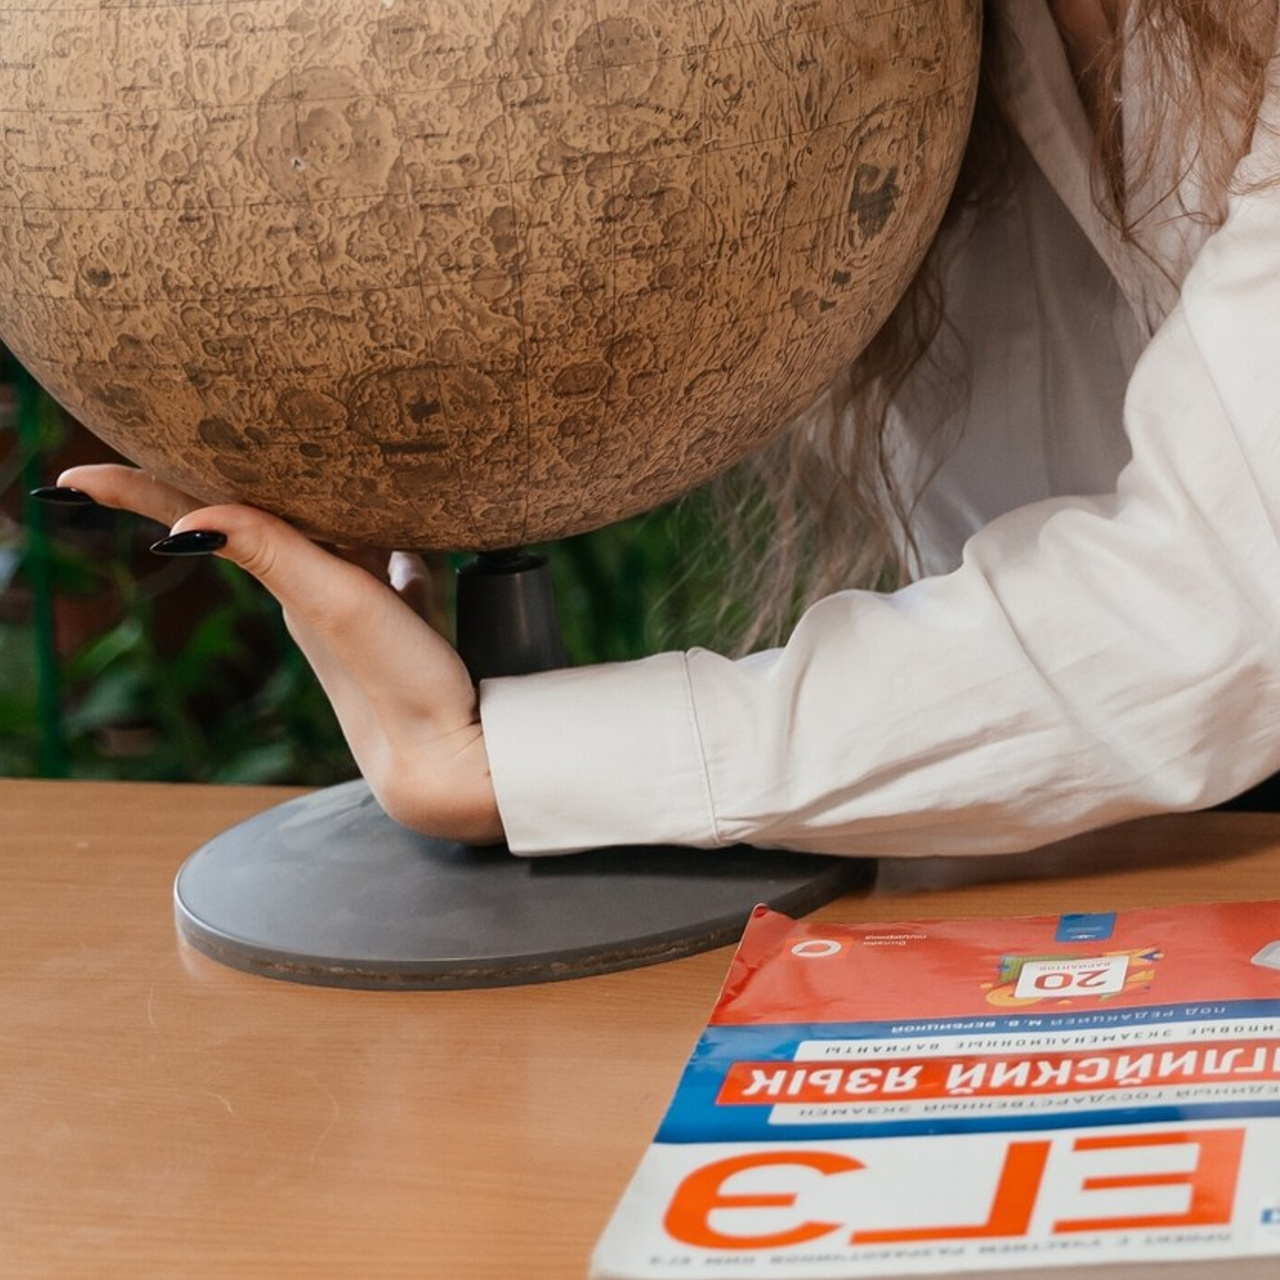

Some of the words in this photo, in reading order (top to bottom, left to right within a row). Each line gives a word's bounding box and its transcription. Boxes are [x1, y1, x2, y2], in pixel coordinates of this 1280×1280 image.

[1039, 962, 1111, 972] ВАРИАНТОВ
[1033, 969, 1110, 990] 20
[1050, 1009, 1174, 1026] РЕДАКЦИЕЙ
[1183, 1006, 1226, 1017] ПОД
[891, 1021, 997, 1034] ВЕРБИЦКОЙ
[953, 1031, 1172, 1049] ЭКЗАМЕНАЦИОННЫЕ
[825, 1042, 940, 1054] ВАРИАНТЫ
[741, 1065, 923, 1096] ЯЗЫК
[1176, 1085, 1280, 1099] ЕДИНЫЙ
[923, 1090, 1163, 1113] ГОСУДАРСТВЕННЫЙ
[798, 1106, 911, 1117] ЭКЗАМЕН
[662, 1128, 1248, 1250] ЕГЭ
